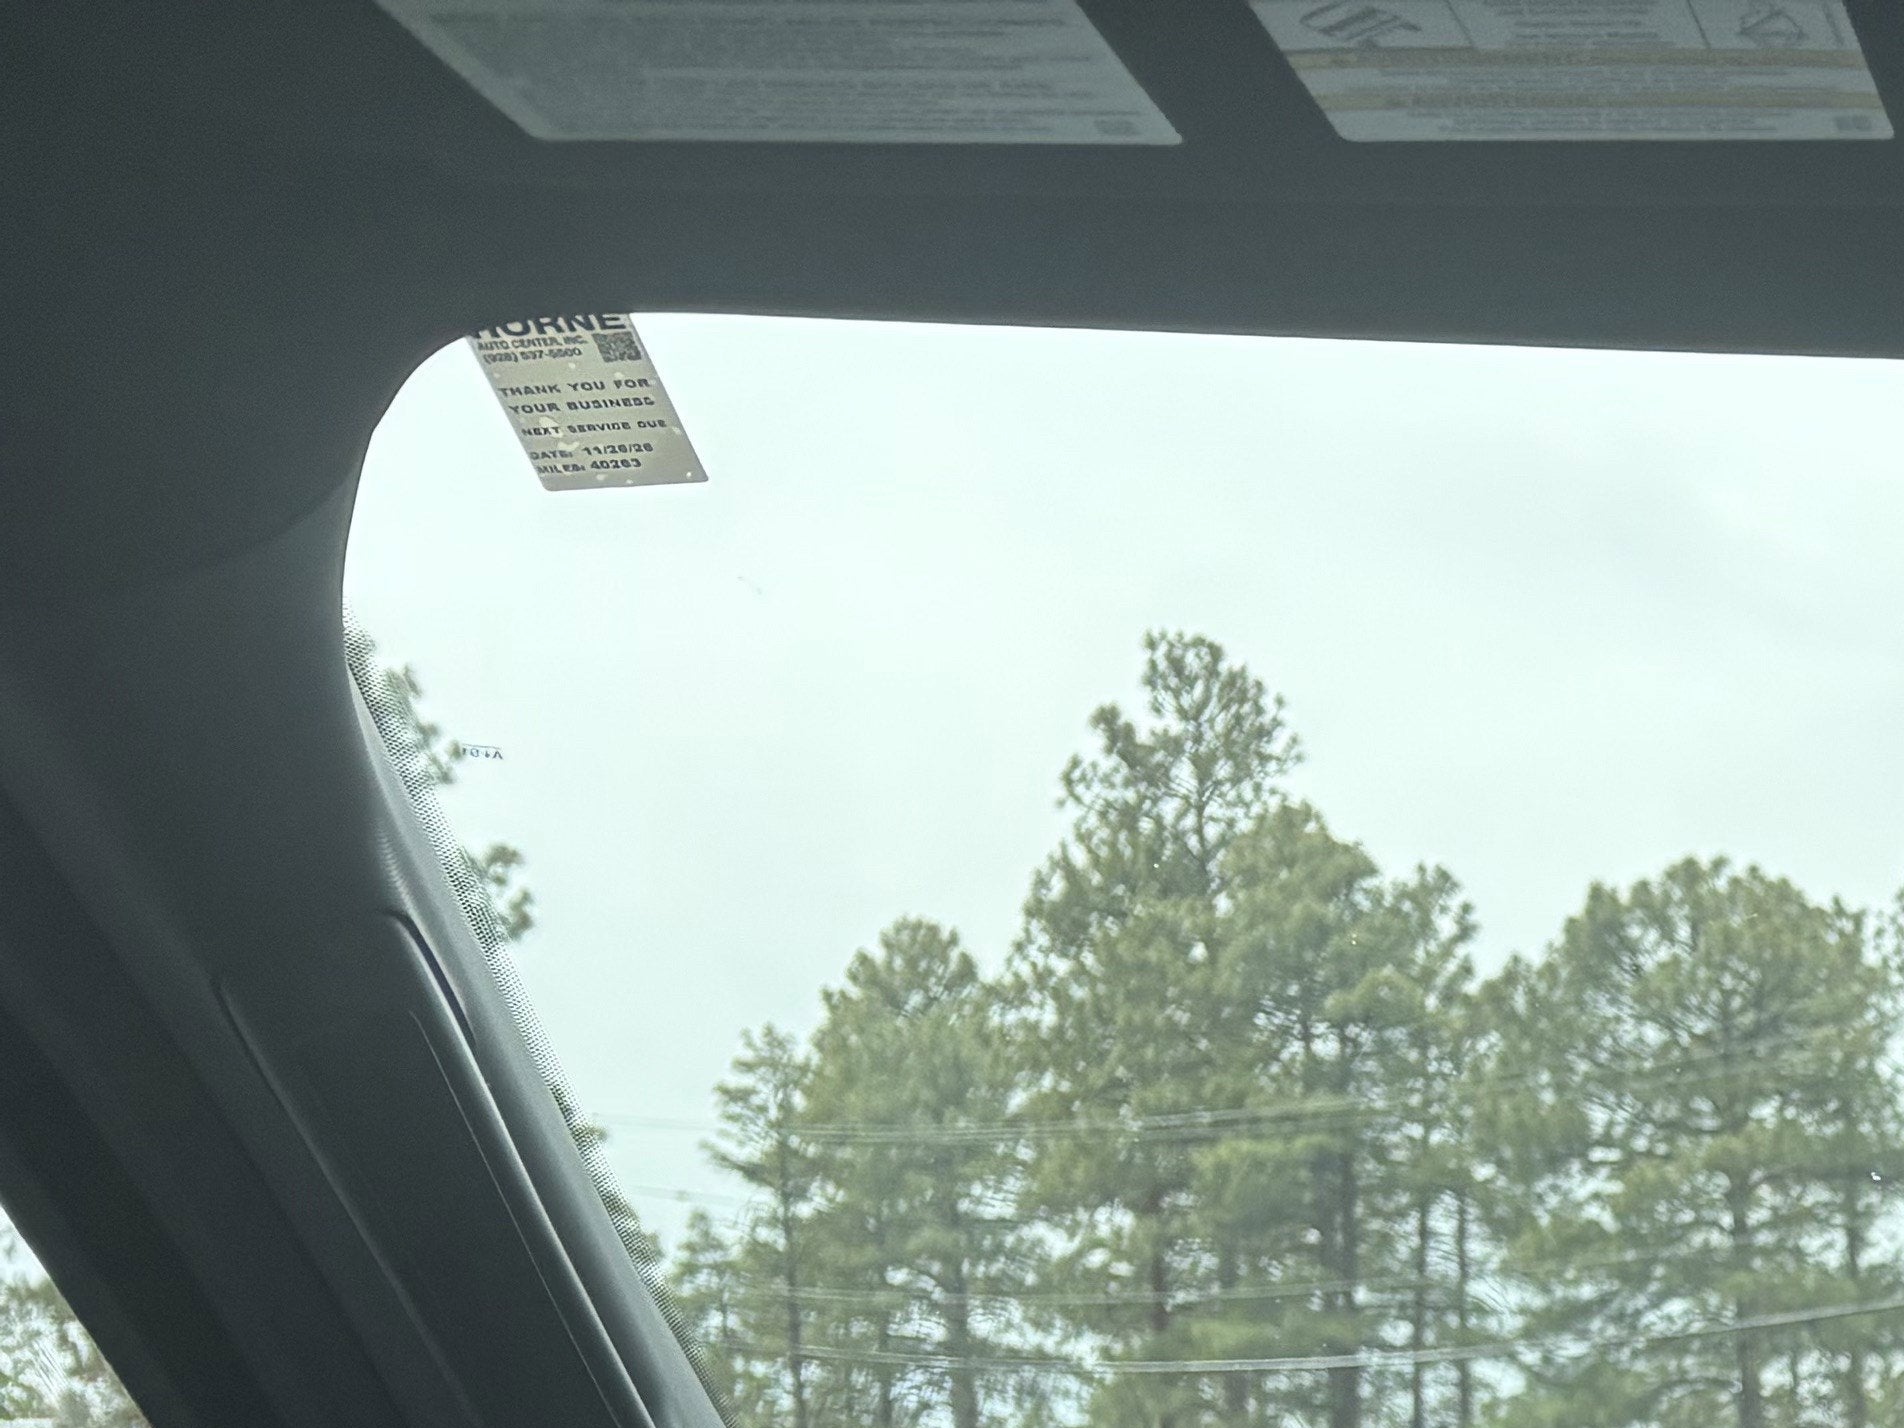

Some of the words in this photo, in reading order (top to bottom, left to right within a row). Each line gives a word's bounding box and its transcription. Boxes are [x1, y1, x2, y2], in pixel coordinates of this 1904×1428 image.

[477, 338, 510, 351] AUTO
[499, 382, 561, 399] THANK
[567, 380, 606, 393] YOU
[613, 377, 650, 391] FOR
[508, 402, 561, 415] YOUR
[566, 396, 656, 412] BUSINESS
[521, 425, 561, 437] NEXT
[567, 420, 632, 435] SERVICE
[637, 418, 667, 429] DUE
[529, 448, 574, 462] DATE:
[535, 462, 586, 475] MILES:
